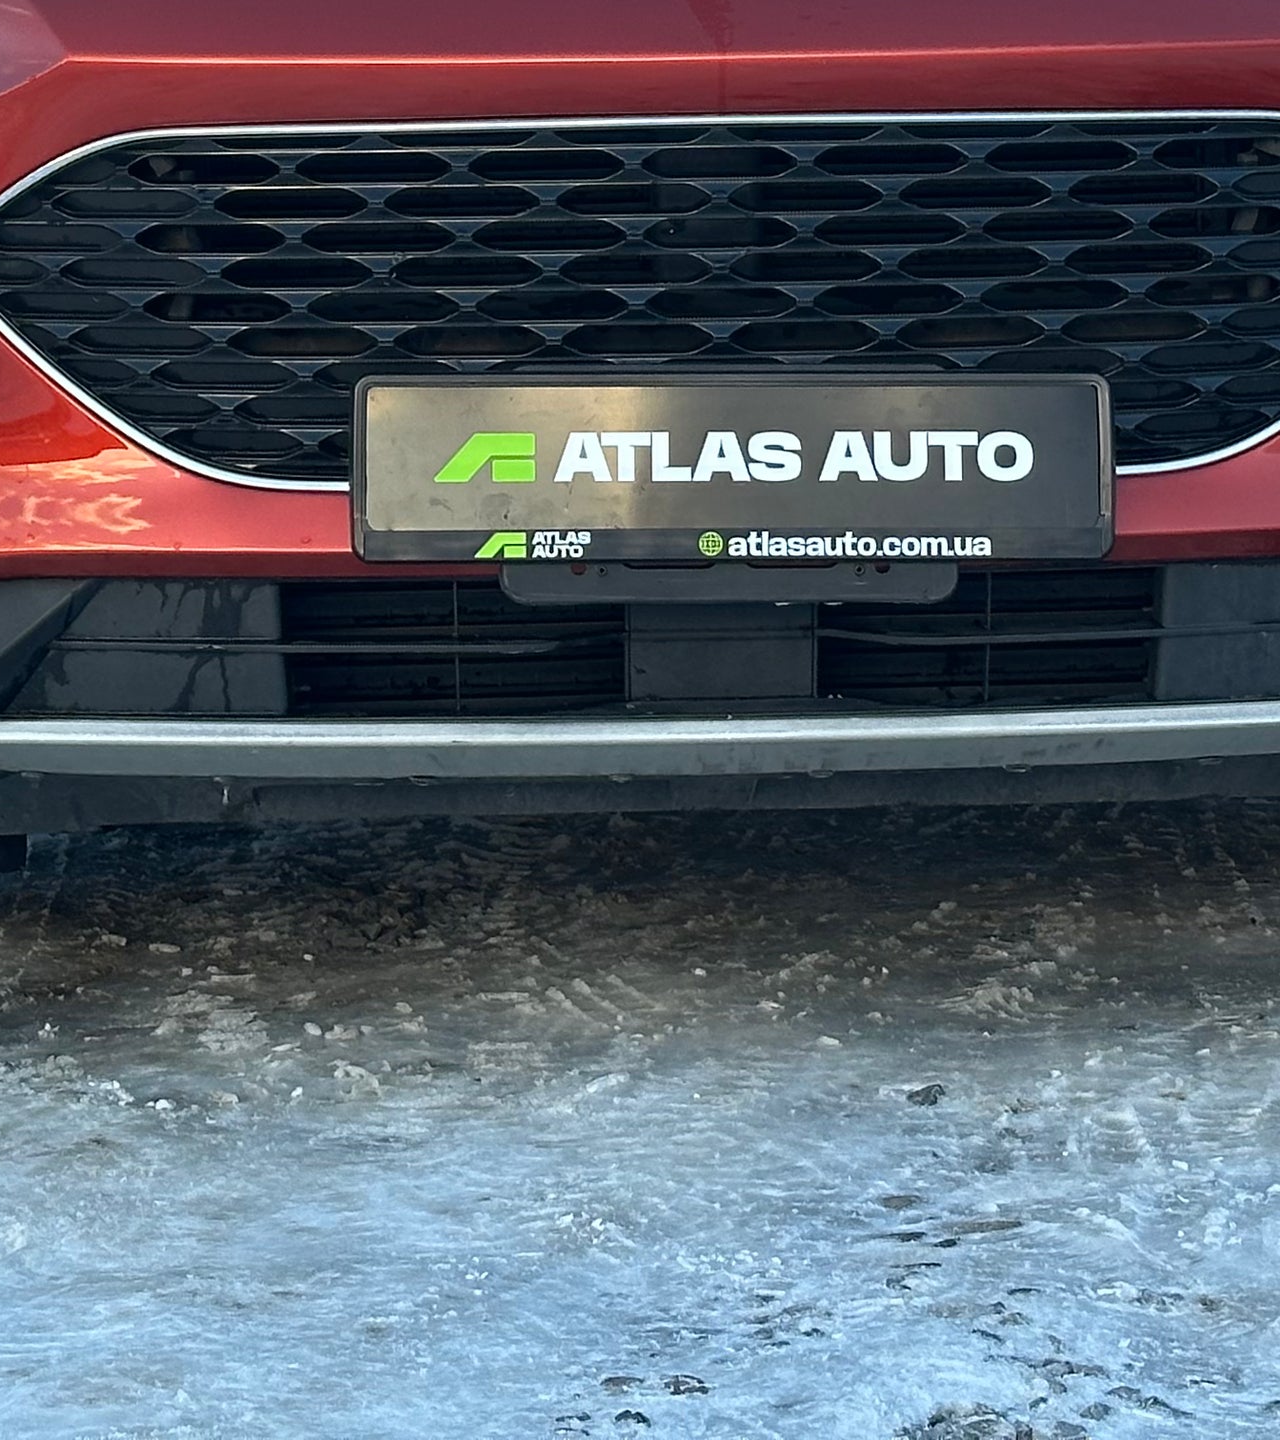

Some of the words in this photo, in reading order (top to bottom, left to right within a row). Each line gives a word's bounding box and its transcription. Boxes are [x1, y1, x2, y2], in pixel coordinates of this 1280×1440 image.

[553, 431, 803, 482] ATLAS
[818, 430, 1034, 482] AUTO
[531, 531, 591, 545] ATLAS
[727, 531, 992, 557] atlasauto.com.ua
[531, 545, 584, 558] AUTO
